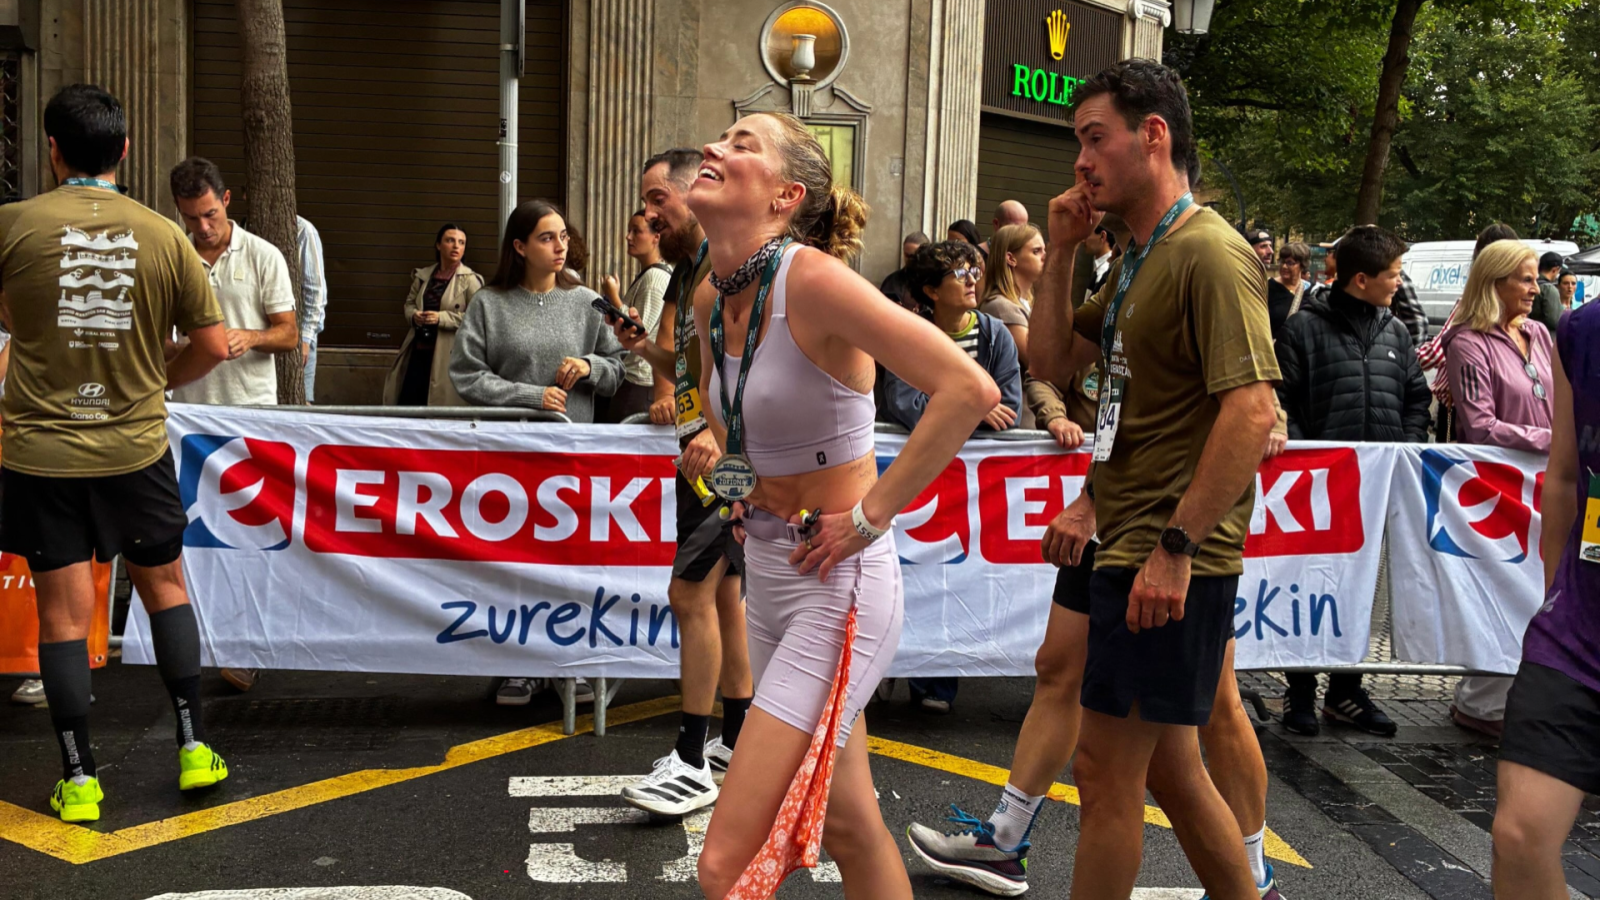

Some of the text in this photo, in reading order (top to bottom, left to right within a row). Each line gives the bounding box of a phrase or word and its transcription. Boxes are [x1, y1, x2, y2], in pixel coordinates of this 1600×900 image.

[1012, 63, 1086, 107] ROLE
[71, 398, 110, 406] HYUNDAI
[95, 412, 109, 420] Car
[677, 392, 695, 415] 63
[334, 468, 677, 543] EROSKI
[436, 586, 680, 648] zurekin
